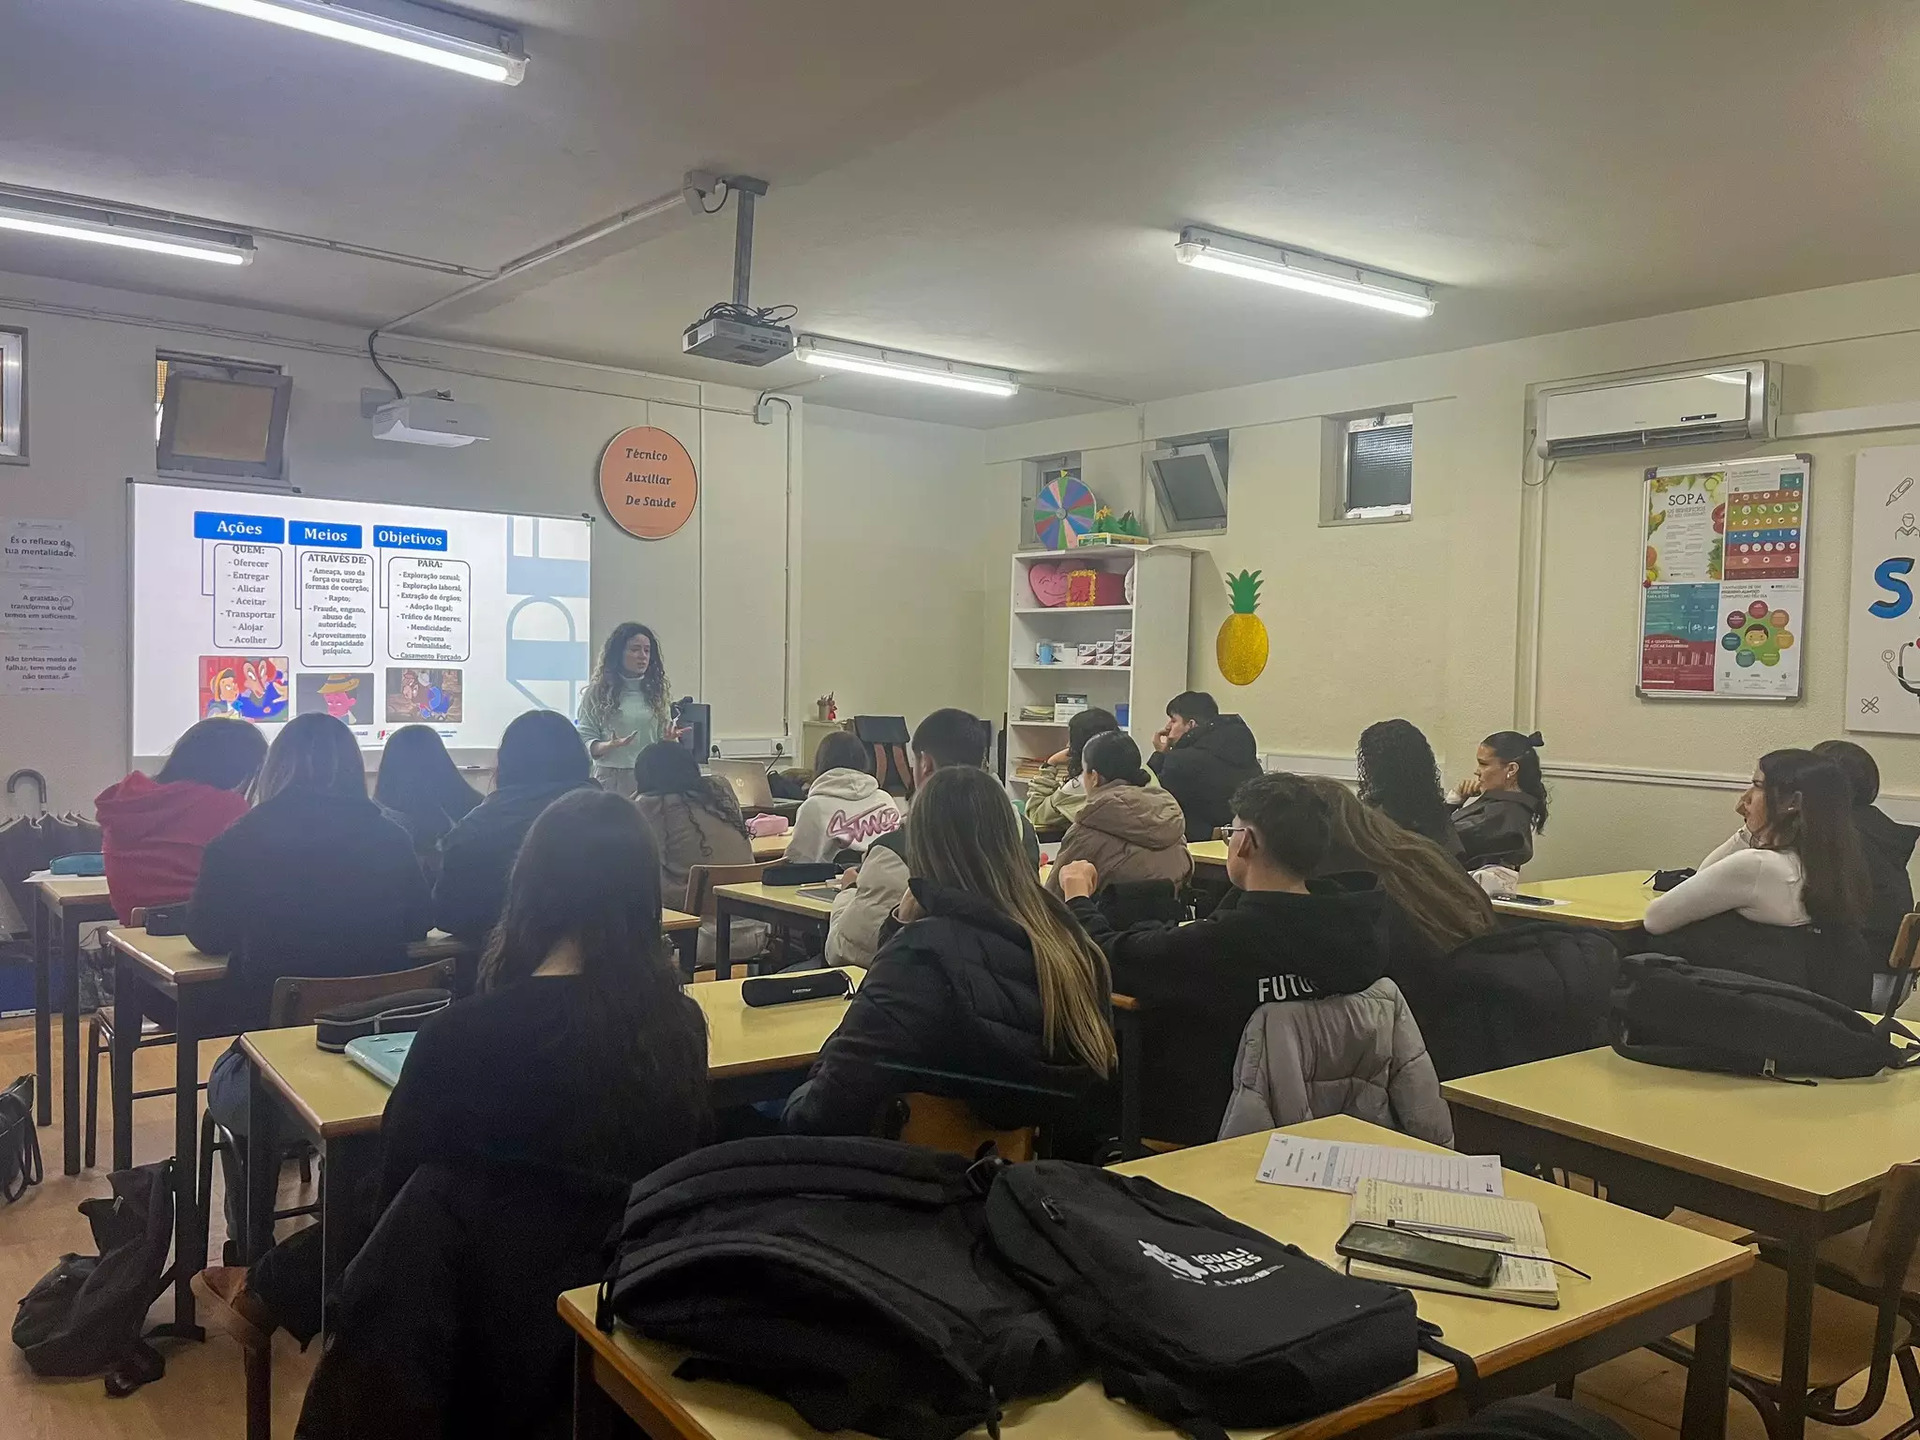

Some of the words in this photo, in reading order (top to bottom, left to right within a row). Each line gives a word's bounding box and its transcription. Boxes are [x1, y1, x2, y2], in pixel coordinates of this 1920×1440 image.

[626, 448, 668, 460] Técnico
[626, 472, 672, 485] Auxiliar
[626, 495, 640, 506] De
[643, 496, 676, 508] Saúde
[1668, 493, 1706, 506] SOPA
[216, 520, 262, 536] Ações
[304, 528, 348, 542] Meios
[378, 530, 442, 546] Objetivos
[10, 535, 20, 544] És
[30, 538, 58, 546] reflexo
[21, 548, 76, 557] mentalidade.
[232, 545, 264, 554] QUEM:
[233, 558, 269, 568] Oferecer
[308, 554, 350, 564] ATRAVÉS
[352, 556, 366, 564] DE:
[418, 560, 442, 568] PARA:
[233, 572, 270, 582] Entregar
[314, 568, 342, 576] Ameaça,
[402, 572, 438, 580] Exploração
[312, 575, 330, 583] força
[402, 582, 437, 590] Exploração
[1868, 557, 1915, 619] S
[236, 598, 266, 606] Aceitar
[226, 610, 276, 620] Transportar
[238, 624, 264, 632] Alojar
[1258, 974, 1316, 1002] FUTU
[1191, 1248, 1250, 1264] IGUALI
[1204, 1254, 1262, 1274] DADES
